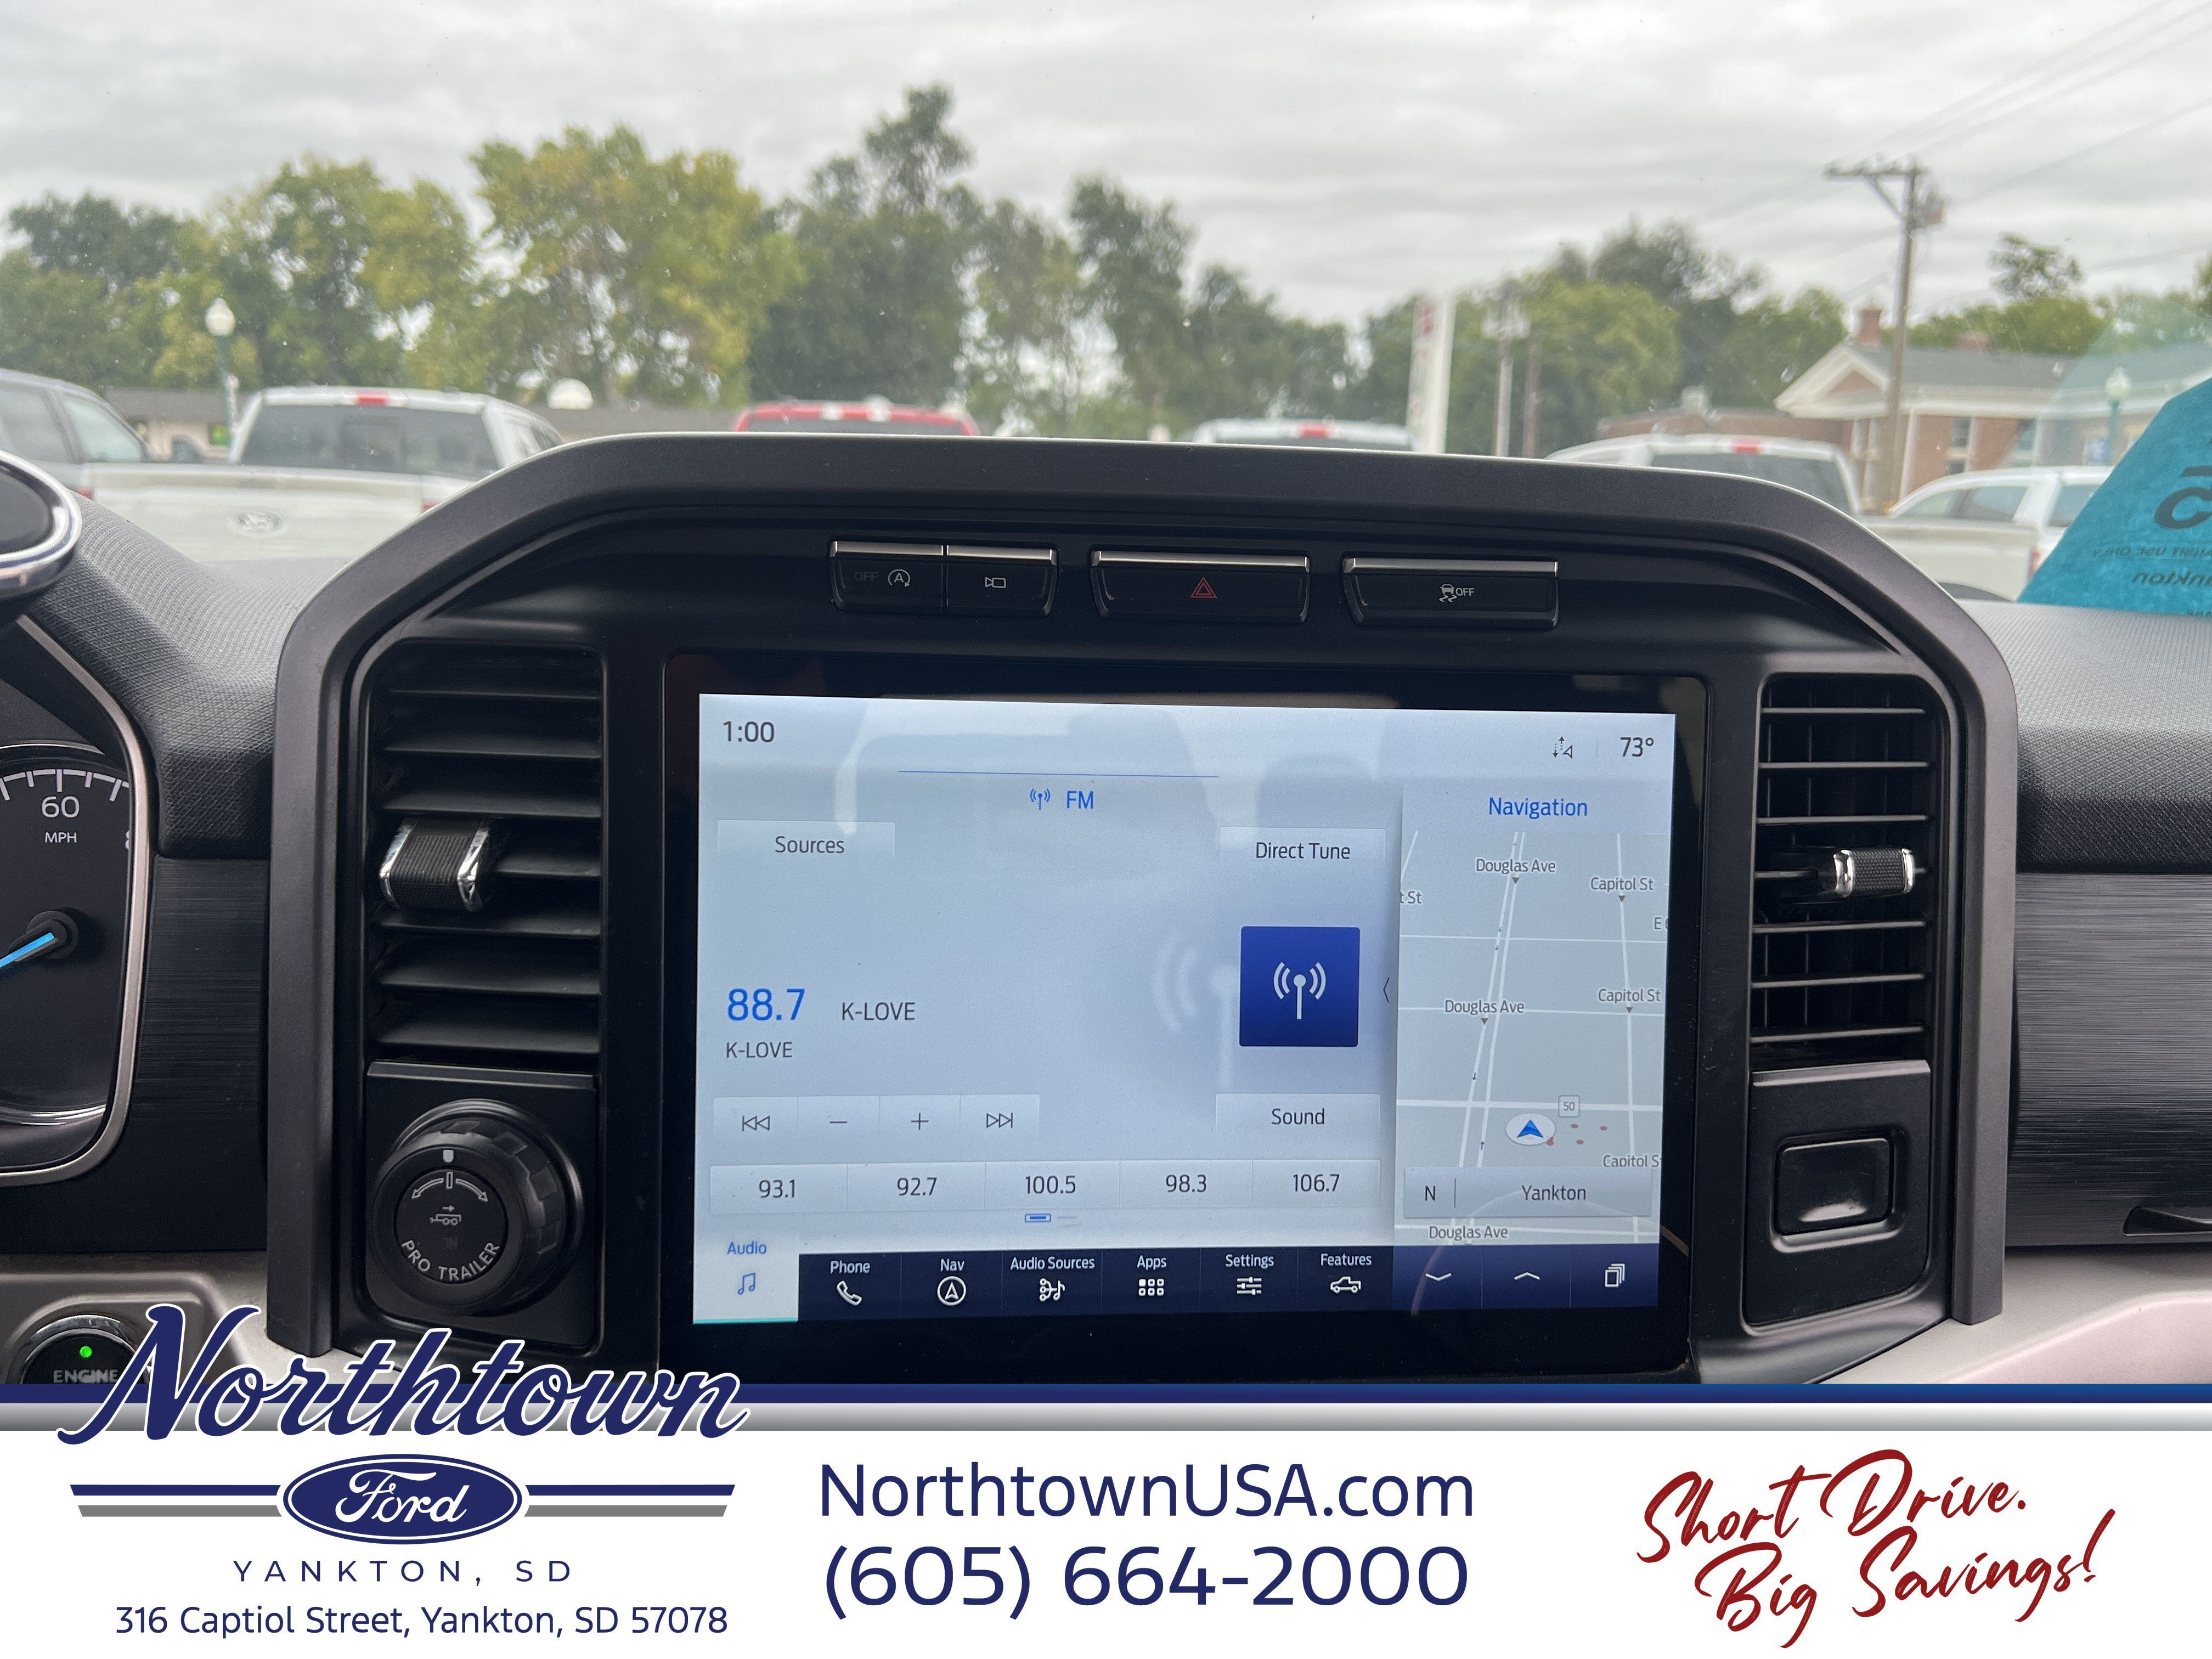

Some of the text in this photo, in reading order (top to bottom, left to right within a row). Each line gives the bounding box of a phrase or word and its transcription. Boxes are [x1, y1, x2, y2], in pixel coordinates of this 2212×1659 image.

[1455, 587, 1475, 597] OFF
[723, 721, 775, 743] 1:00
[1620, 737, 1654, 757] 73°
[42, 796, 80, 818] 60
[1066, 791, 1094, 809] FM
[1489, 797, 1587, 820] Navigation
[44, 832, 77, 843] MPH
[775, 836, 845, 854] Sources
[1256, 842, 1350, 860] Direct Tune
[1476, 859, 1556, 875] Douglas Ave
[1590, 877, 1654, 893] Capitol St
[1407, 891, 1422, 904] St
[1654, 917, 1662, 929] E
[727, 988, 915, 1021] 88.7 K-LOVE
[1598, 989, 1661, 1004] Capitol St
[1445, 1000, 1525, 1015] Douglas Ave
[726, 1041, 792, 1058] K-LOVE
[1563, 1102, 1575, 1111] 50
[1271, 1107, 1325, 1125] Sound
[1651, 1154, 1662, 1168] S
[759, 1179, 795, 1198] 93.1
[897, 1177, 937, 1196] 92.7
[1025, 1175, 1076, 1194] 100.5
[1166, 1174, 1206, 1193] 98.3
[1293, 1173, 1340, 1192] 106.7
[1425, 1186, 1436, 1201] N
[1521, 1184, 1586, 1201] Yankton
[1429, 1225, 1508, 1242] Douglas Ave
[727, 1240, 767, 1255] Audio
[401, 1240, 431, 1272] PRO
[438, 1243, 500, 1281] TRAILER
[830, 1260, 871, 1274] Phone
[940, 1258, 965, 1272] Nav
[1010, 1256, 1095, 1271] Audio Sources
[1137, 1255, 1167, 1270] Apps
[1225, 1254, 1274, 1269] Settings
[1321, 1253, 1372, 1266] Features
